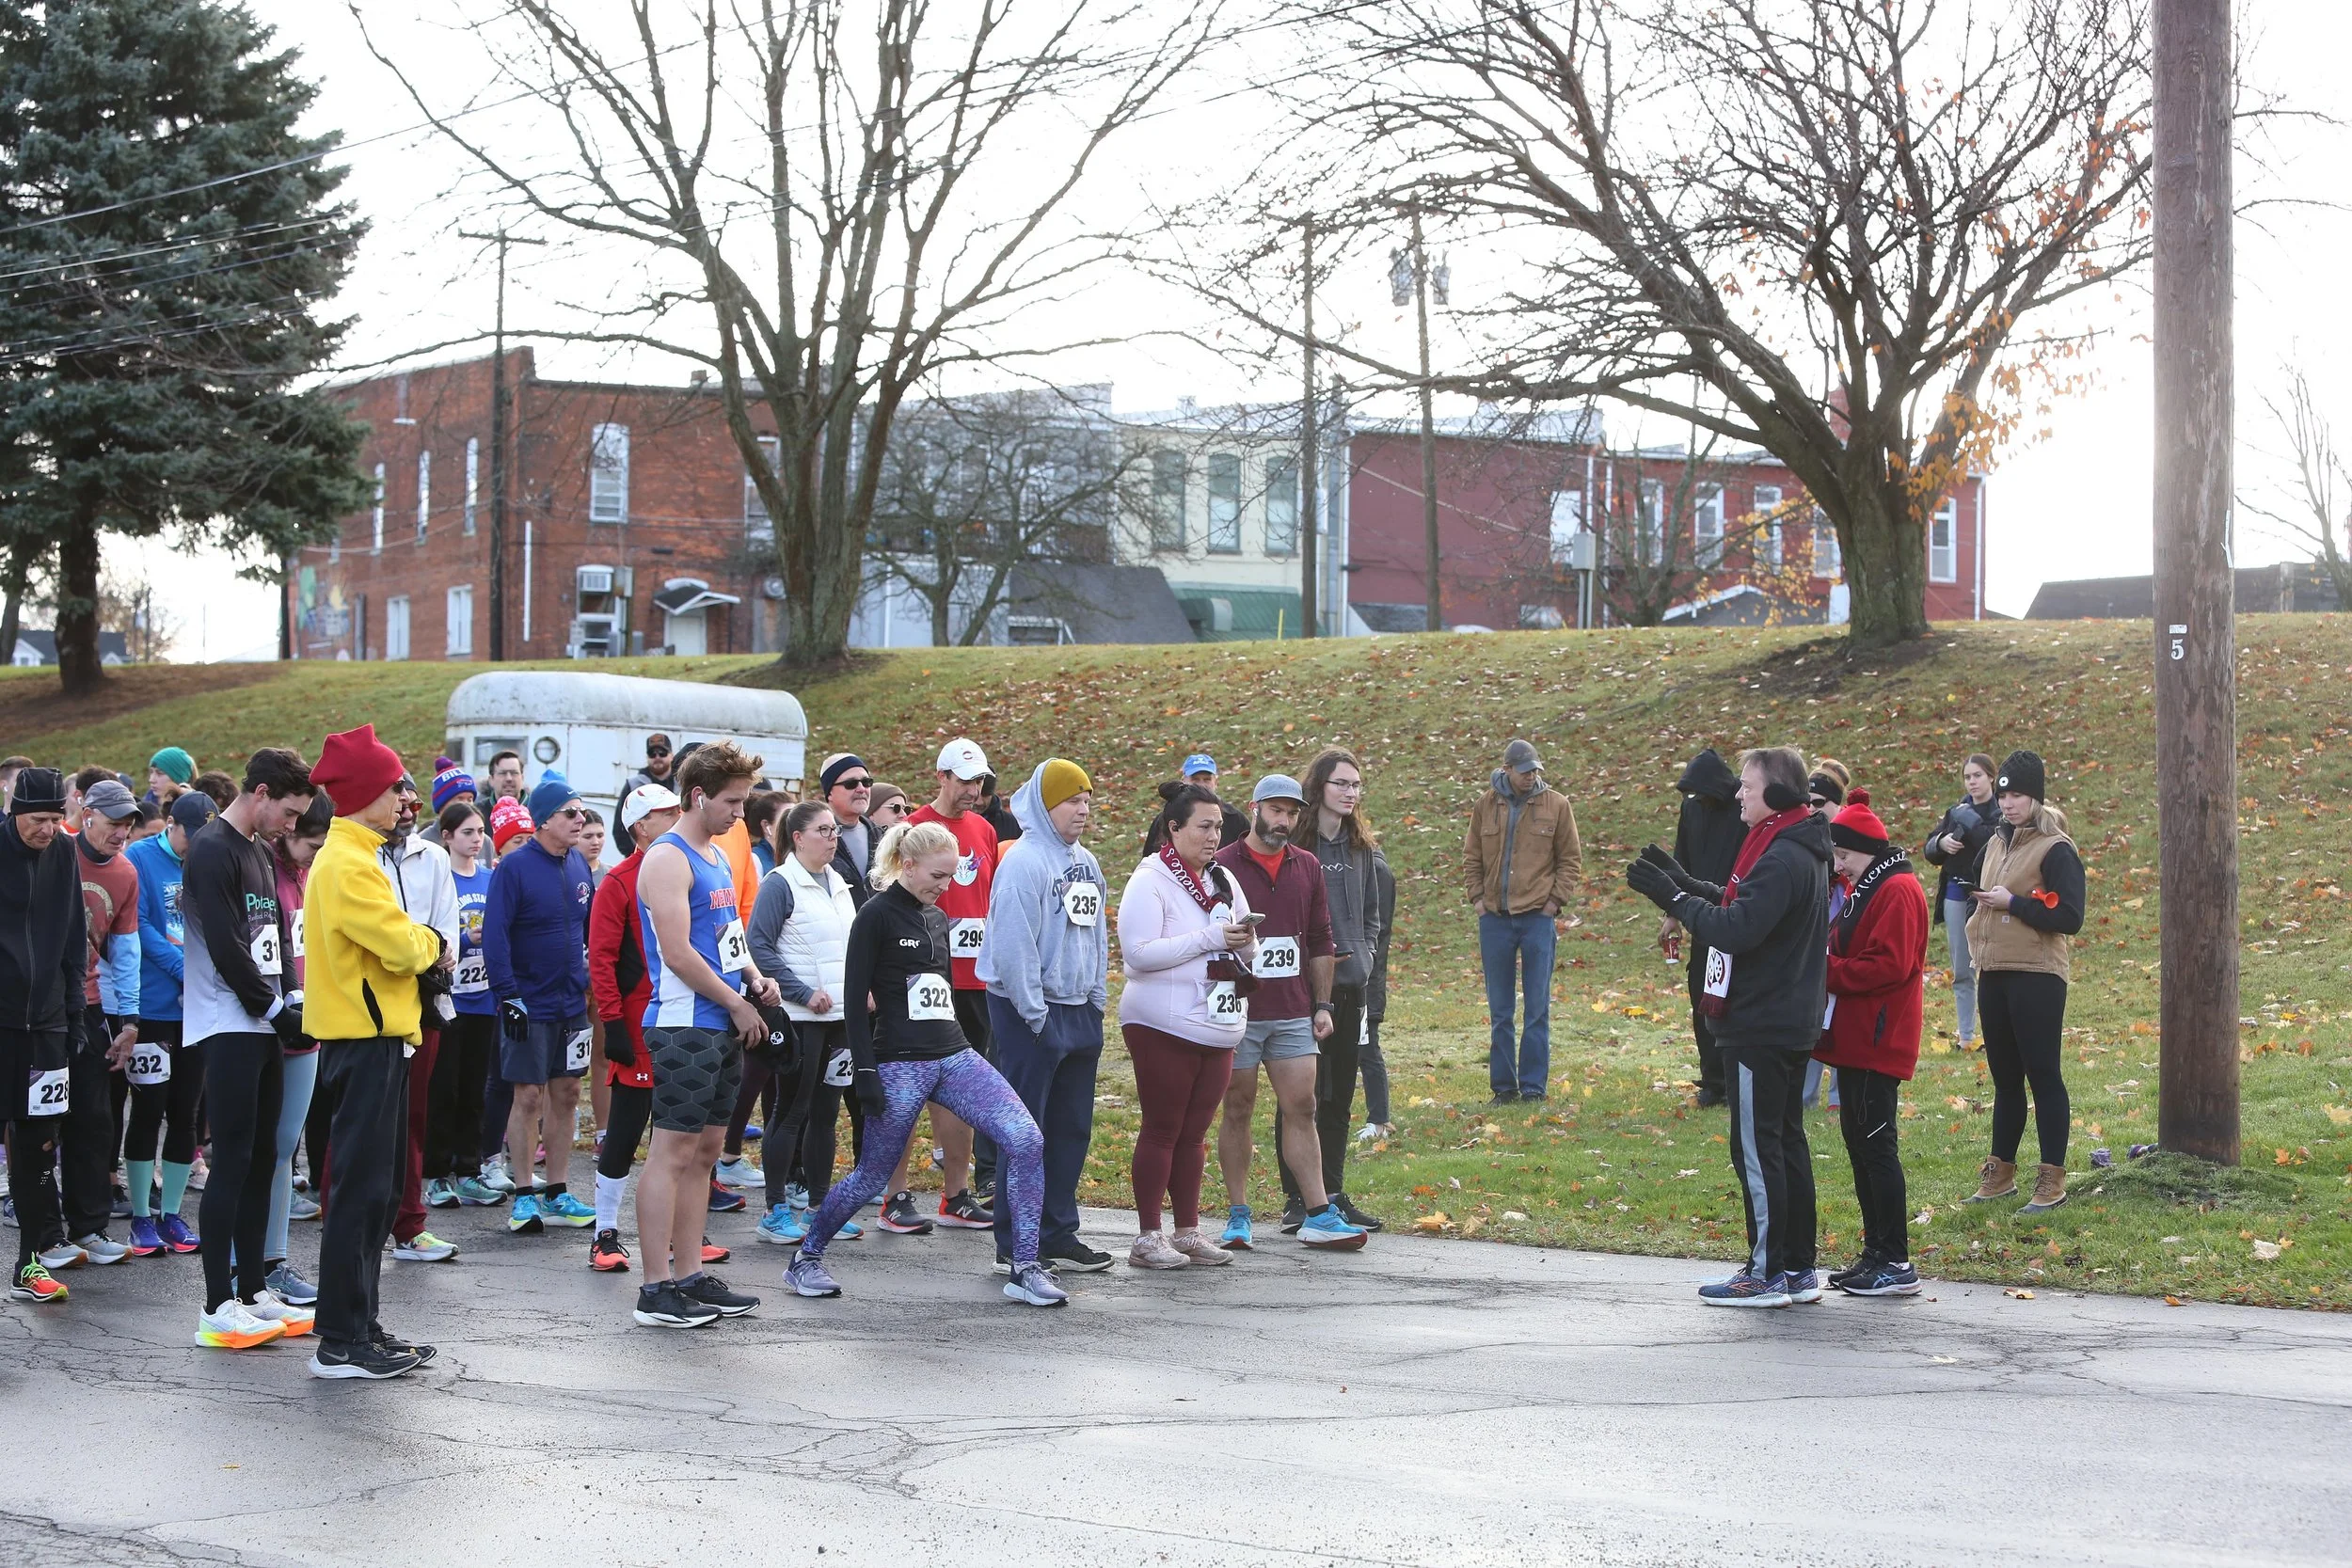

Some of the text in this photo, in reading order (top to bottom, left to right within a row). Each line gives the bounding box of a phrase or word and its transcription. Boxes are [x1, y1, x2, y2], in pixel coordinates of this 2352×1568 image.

[2170, 638, 2185, 660] 5
[1072, 895, 1098, 916] 235
[1263, 947, 1295, 968] 239
[919, 987, 950, 1008] 322
[1216, 993, 1242, 1014] 236
[128, 1054, 163, 1074] 232
